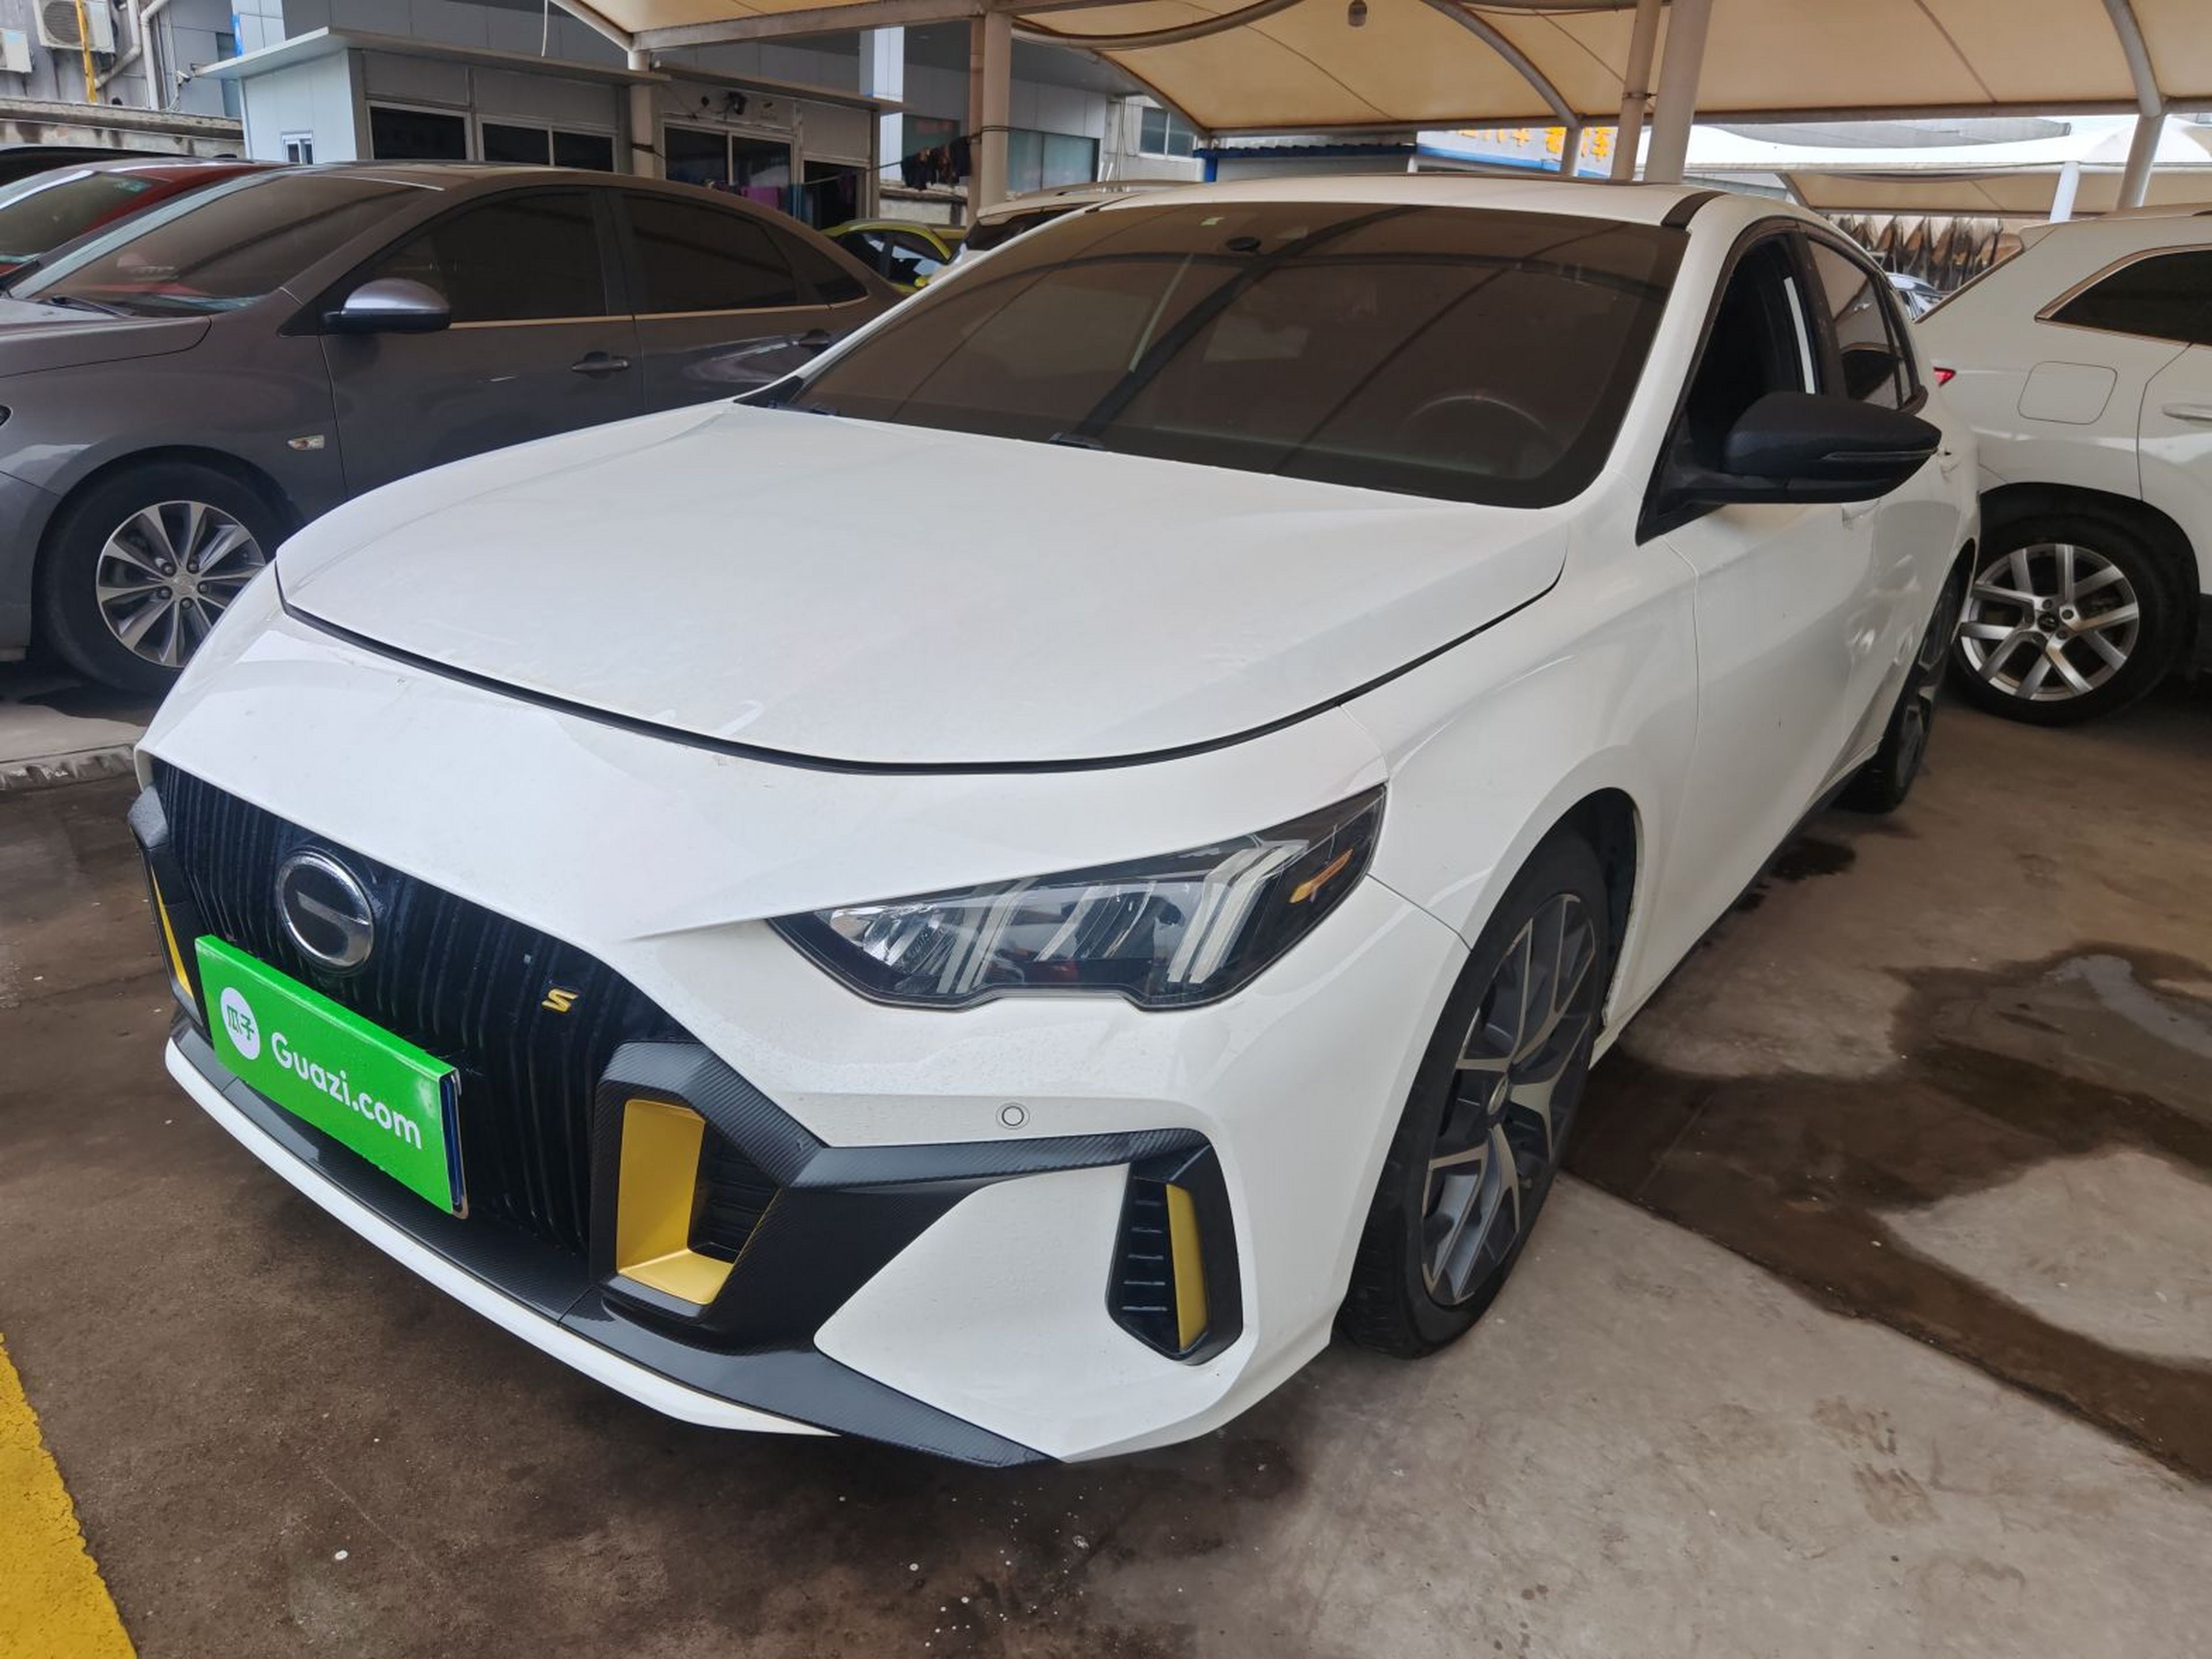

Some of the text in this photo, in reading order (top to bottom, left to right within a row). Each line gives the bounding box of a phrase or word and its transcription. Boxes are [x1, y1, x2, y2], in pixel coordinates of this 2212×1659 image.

[541, 988, 578, 1012] S
[226, 1004, 254, 1040] 瓜子
[271, 1032, 422, 1149] Guazi.com
